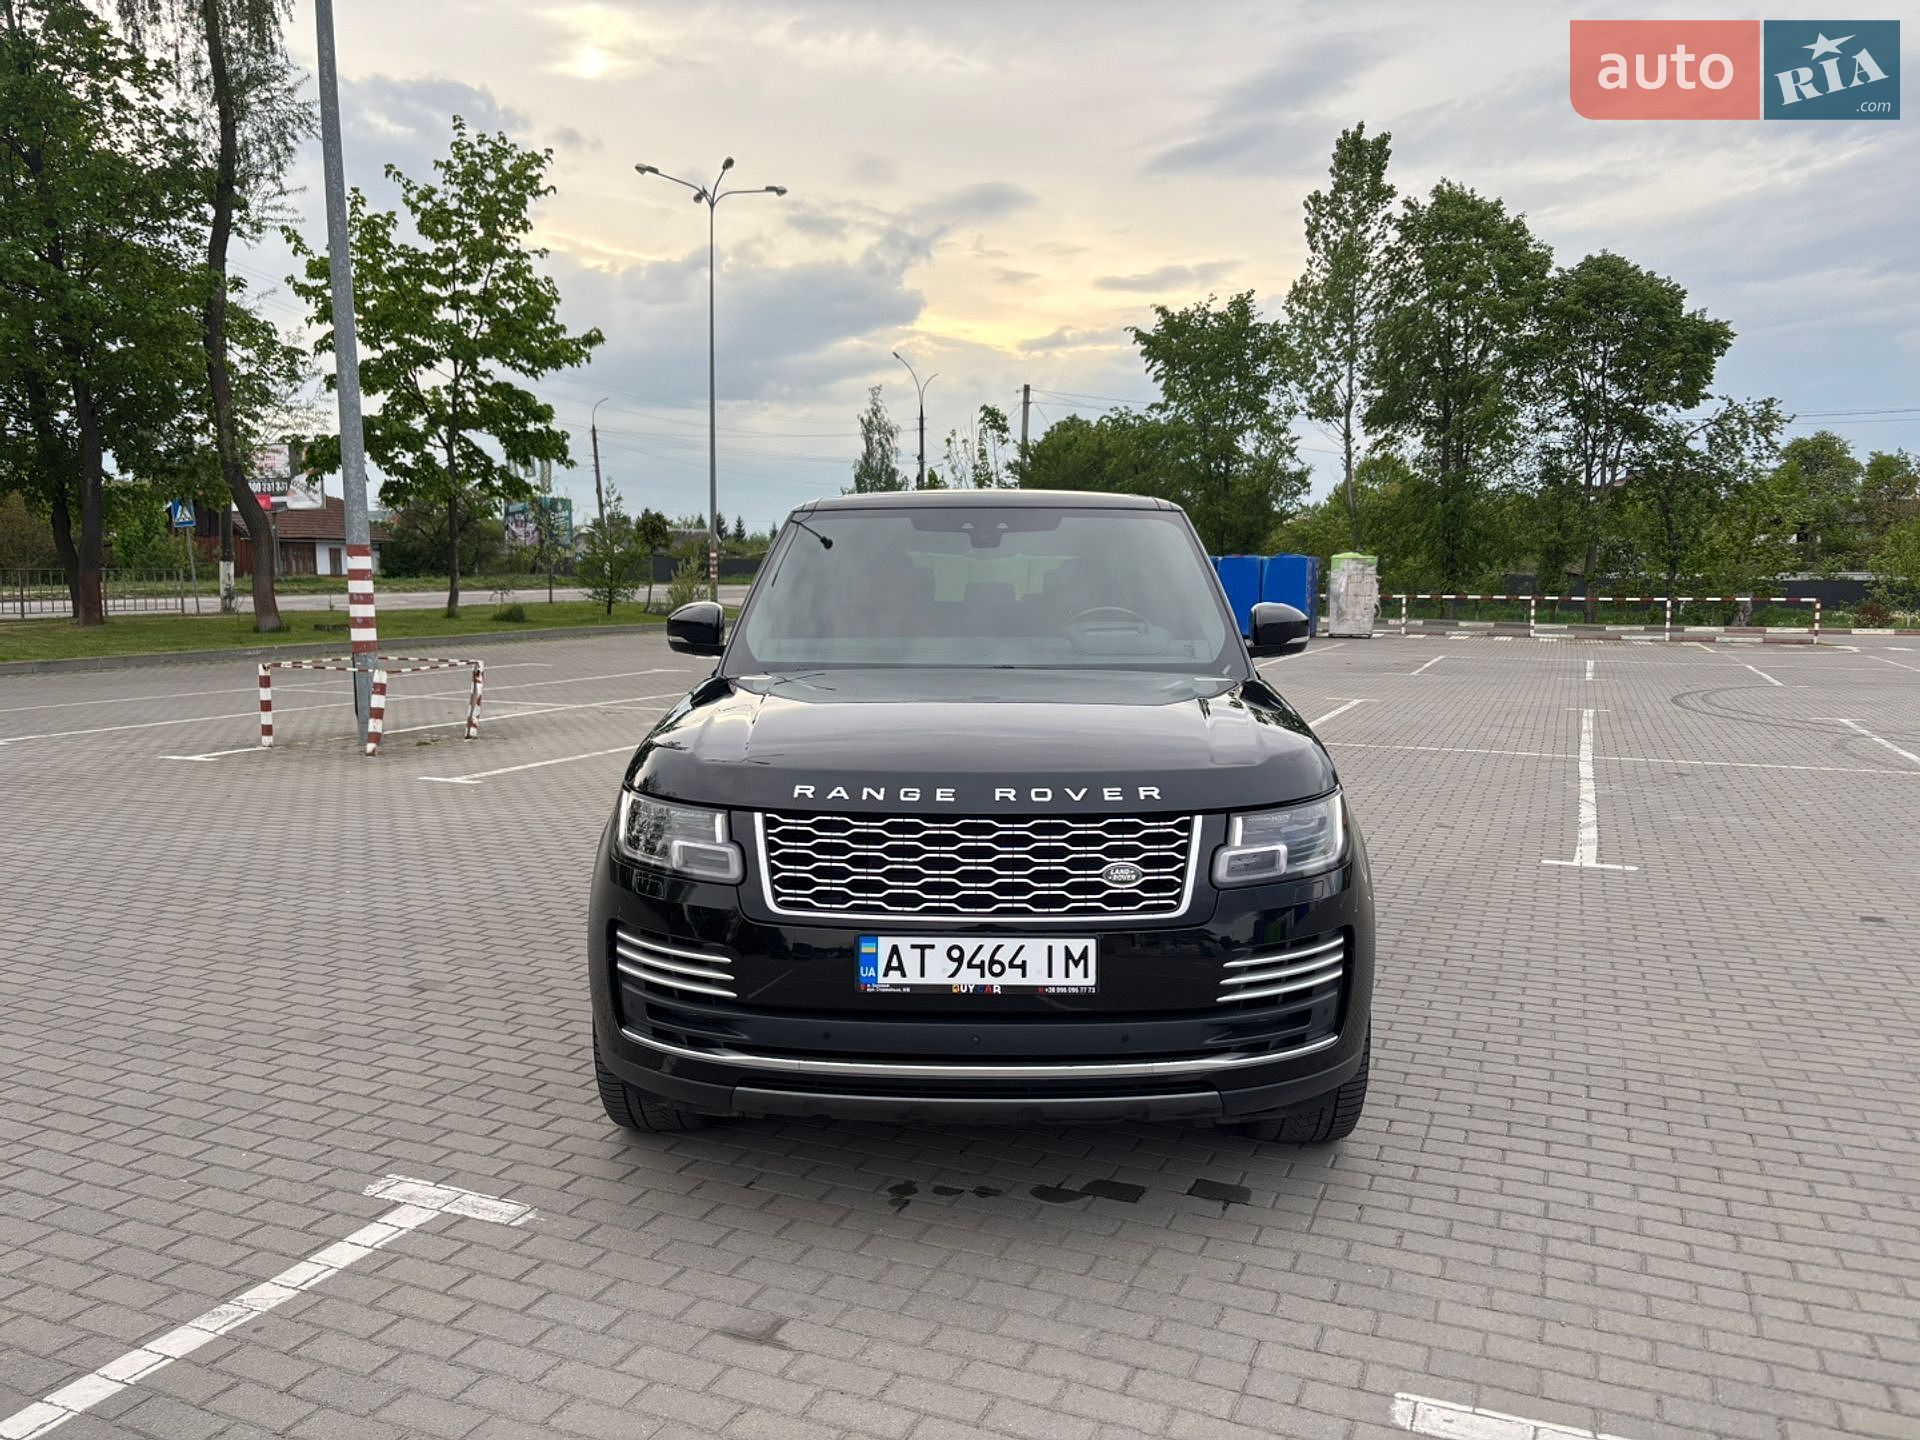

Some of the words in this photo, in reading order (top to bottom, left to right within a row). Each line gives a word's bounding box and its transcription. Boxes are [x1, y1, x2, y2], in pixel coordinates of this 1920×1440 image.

[793, 783, 956, 802] RANGE
[994, 785, 1163, 802] ROVER
[881, 944, 936, 978] AT
[945, 944, 1028, 979] 9464
[1046, 944, 1090, 979] IM
[860, 966, 876, 977] UA
